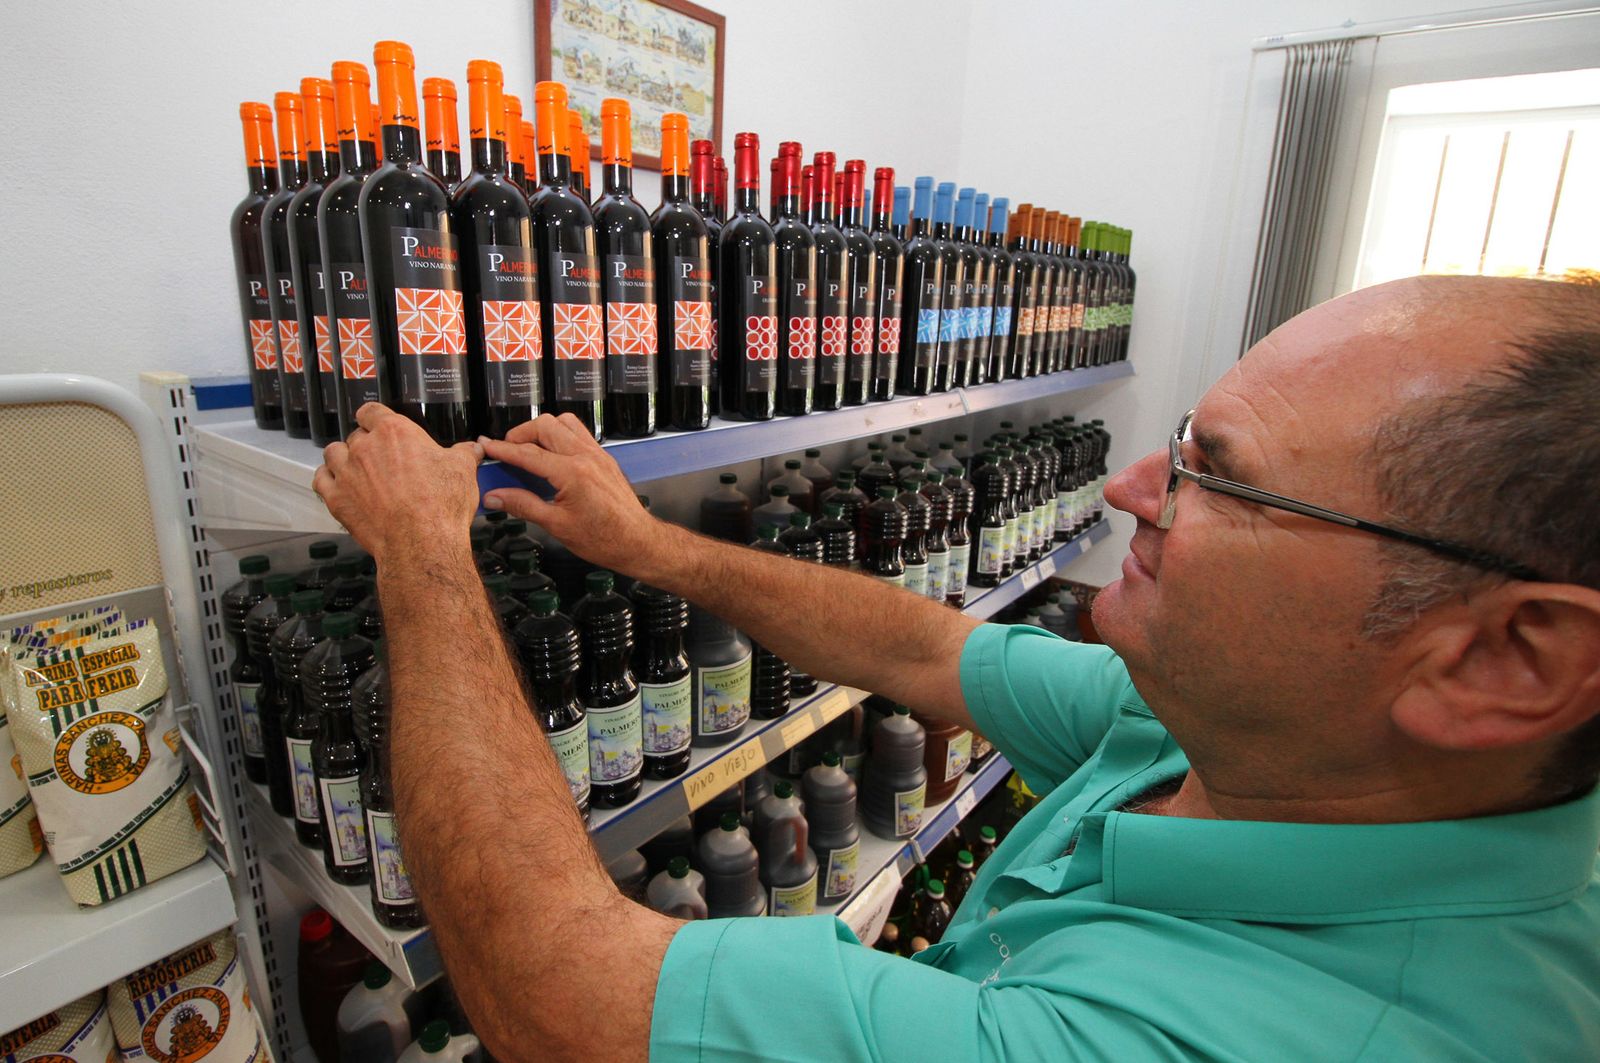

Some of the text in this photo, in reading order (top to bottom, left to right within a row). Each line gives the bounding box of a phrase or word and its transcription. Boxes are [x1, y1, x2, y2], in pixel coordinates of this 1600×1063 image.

[409, 261, 429, 269] VINO
[346, 292, 364, 300] VINO
[11, 568, 113, 598] reposteros
[26, 645, 137, 684] HARINA ESPECIAL
[38, 669, 136, 708] PARA FREIR
[604, 715, 626, 723] VINAGRE
[56, 749, 94, 793] HARINAS
[688, 747, 756, 799] VINO VIEJO
[129, 944, 214, 999] REPOSTERIA
[147, 987, 229, 1042] SANCHEZ-PALENCIA
